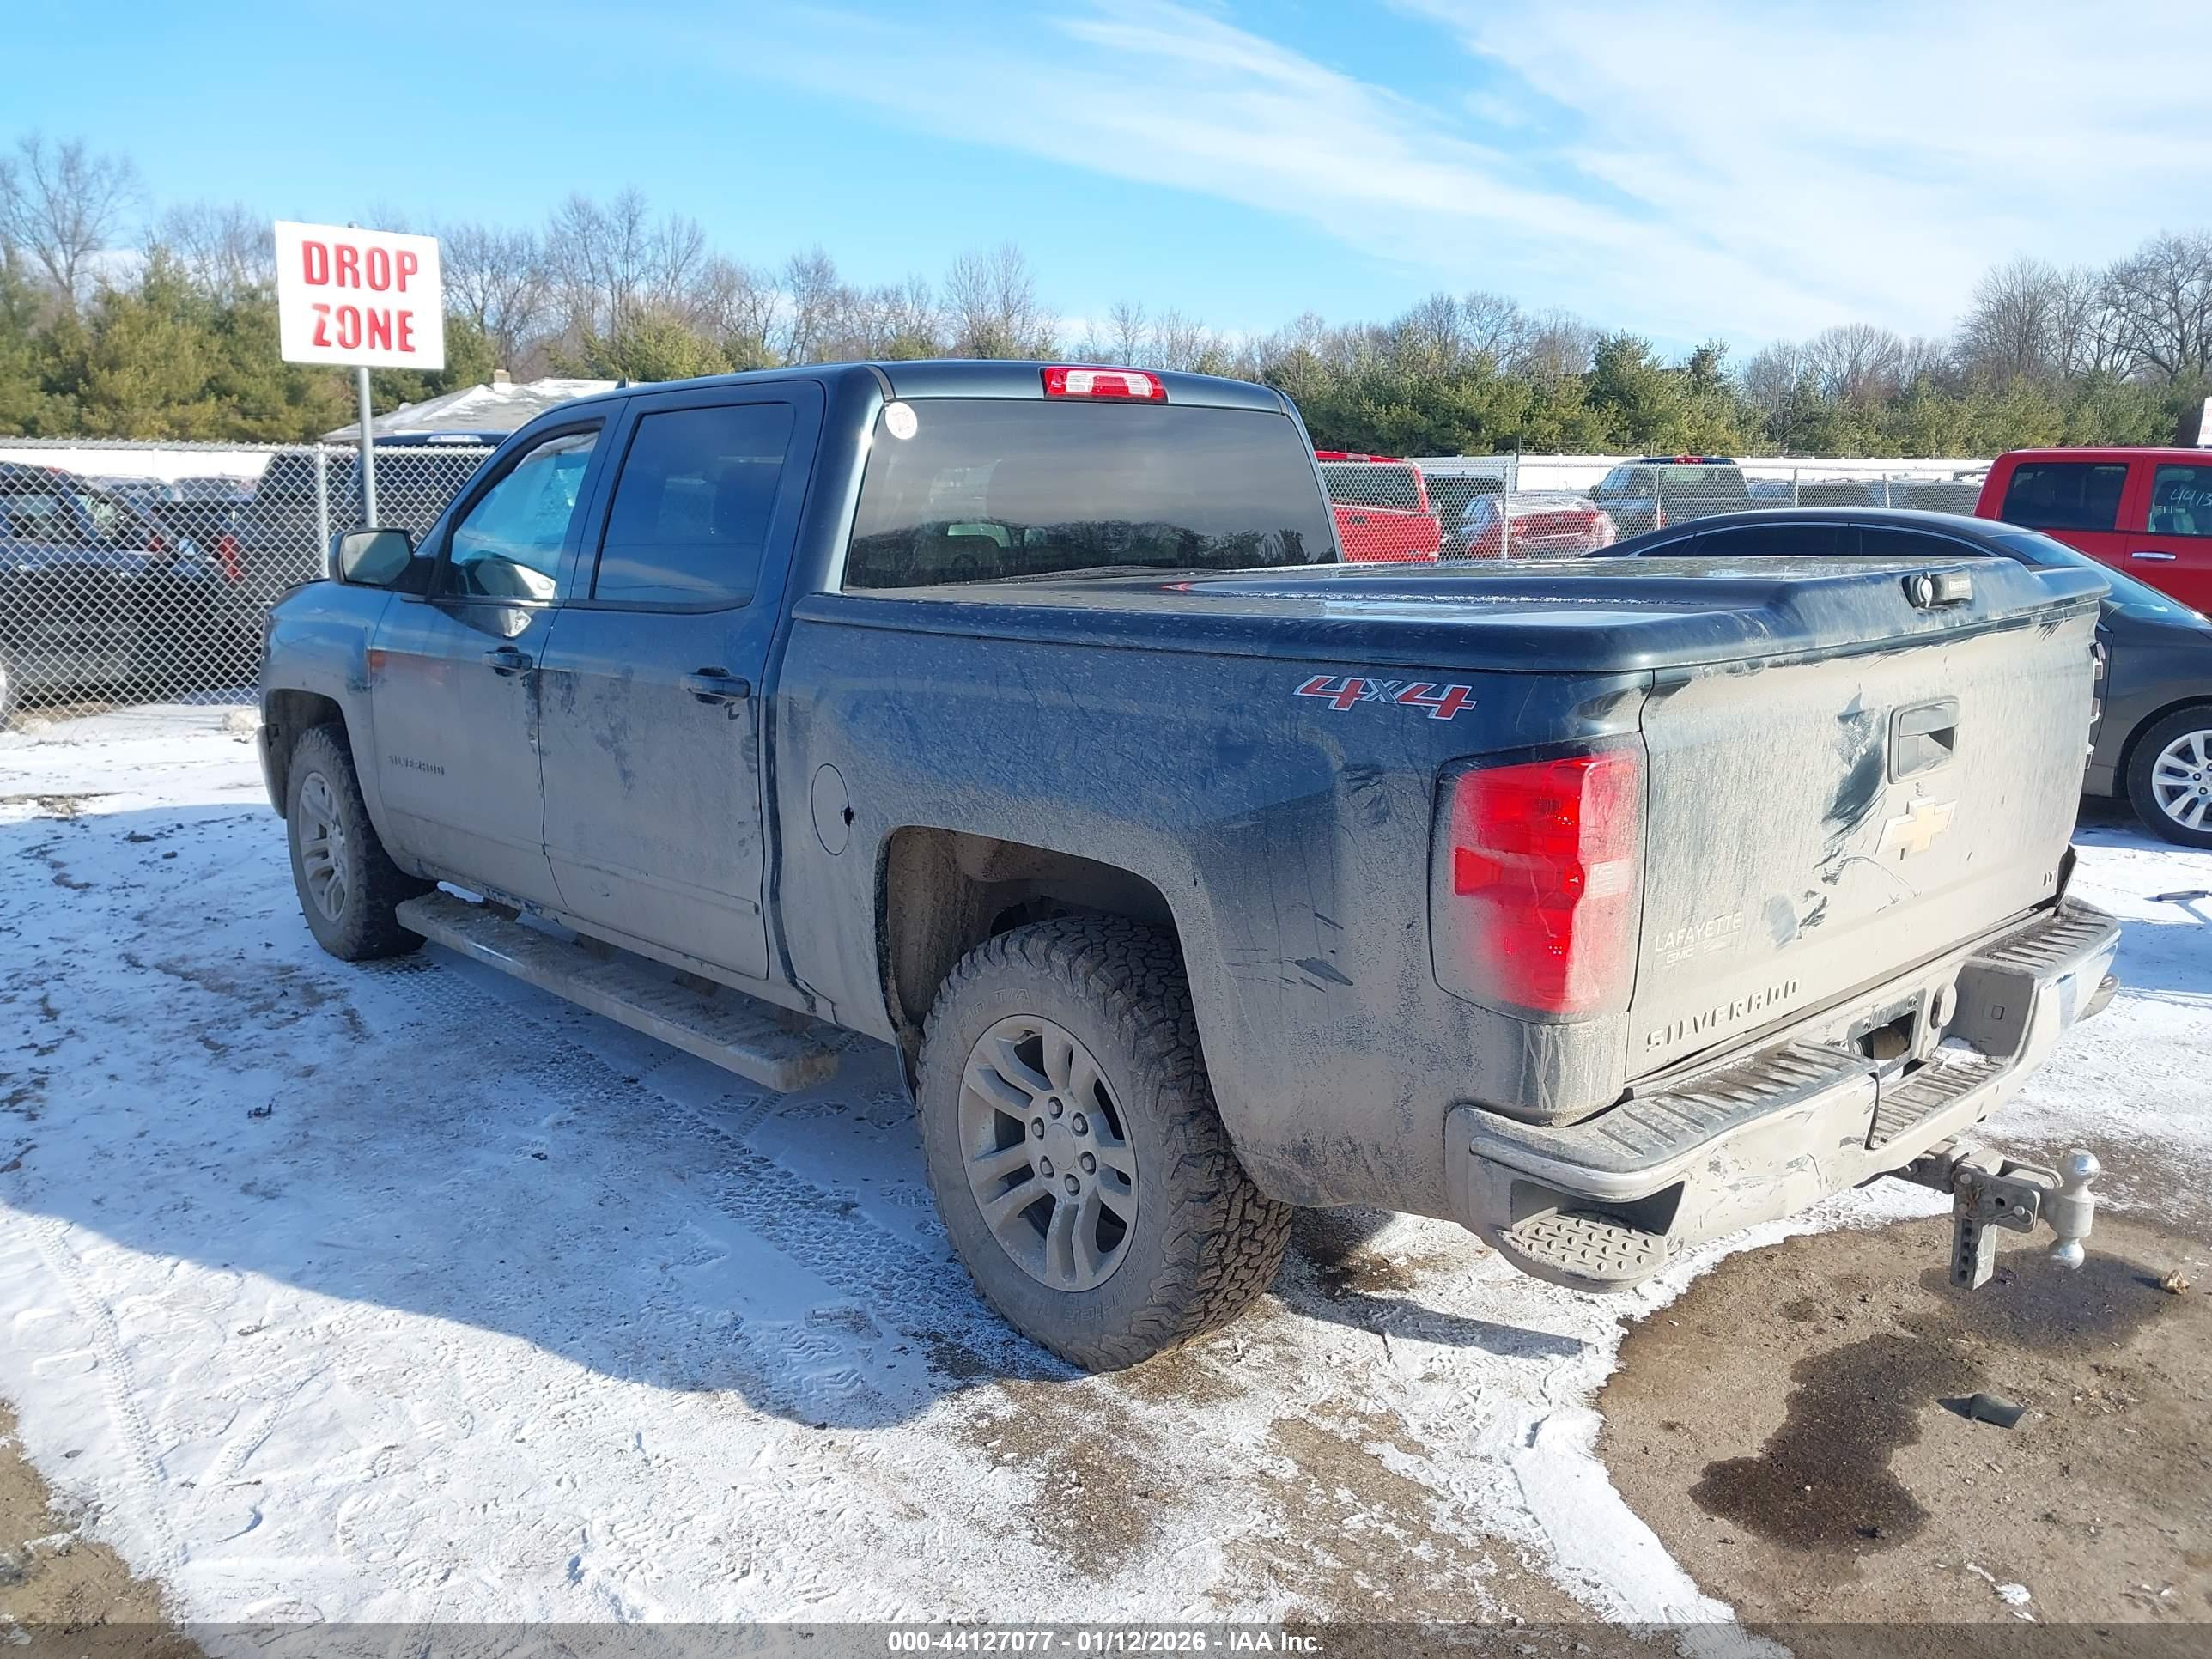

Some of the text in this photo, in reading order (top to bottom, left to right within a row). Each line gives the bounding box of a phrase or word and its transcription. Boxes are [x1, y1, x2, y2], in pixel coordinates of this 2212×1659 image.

[301, 240, 419, 293] DROP
[311, 302, 416, 353] ZONE
[1655, 911, 1742, 953] LAFAYETTE
[1646, 977, 1800, 1053] SILVERADO
